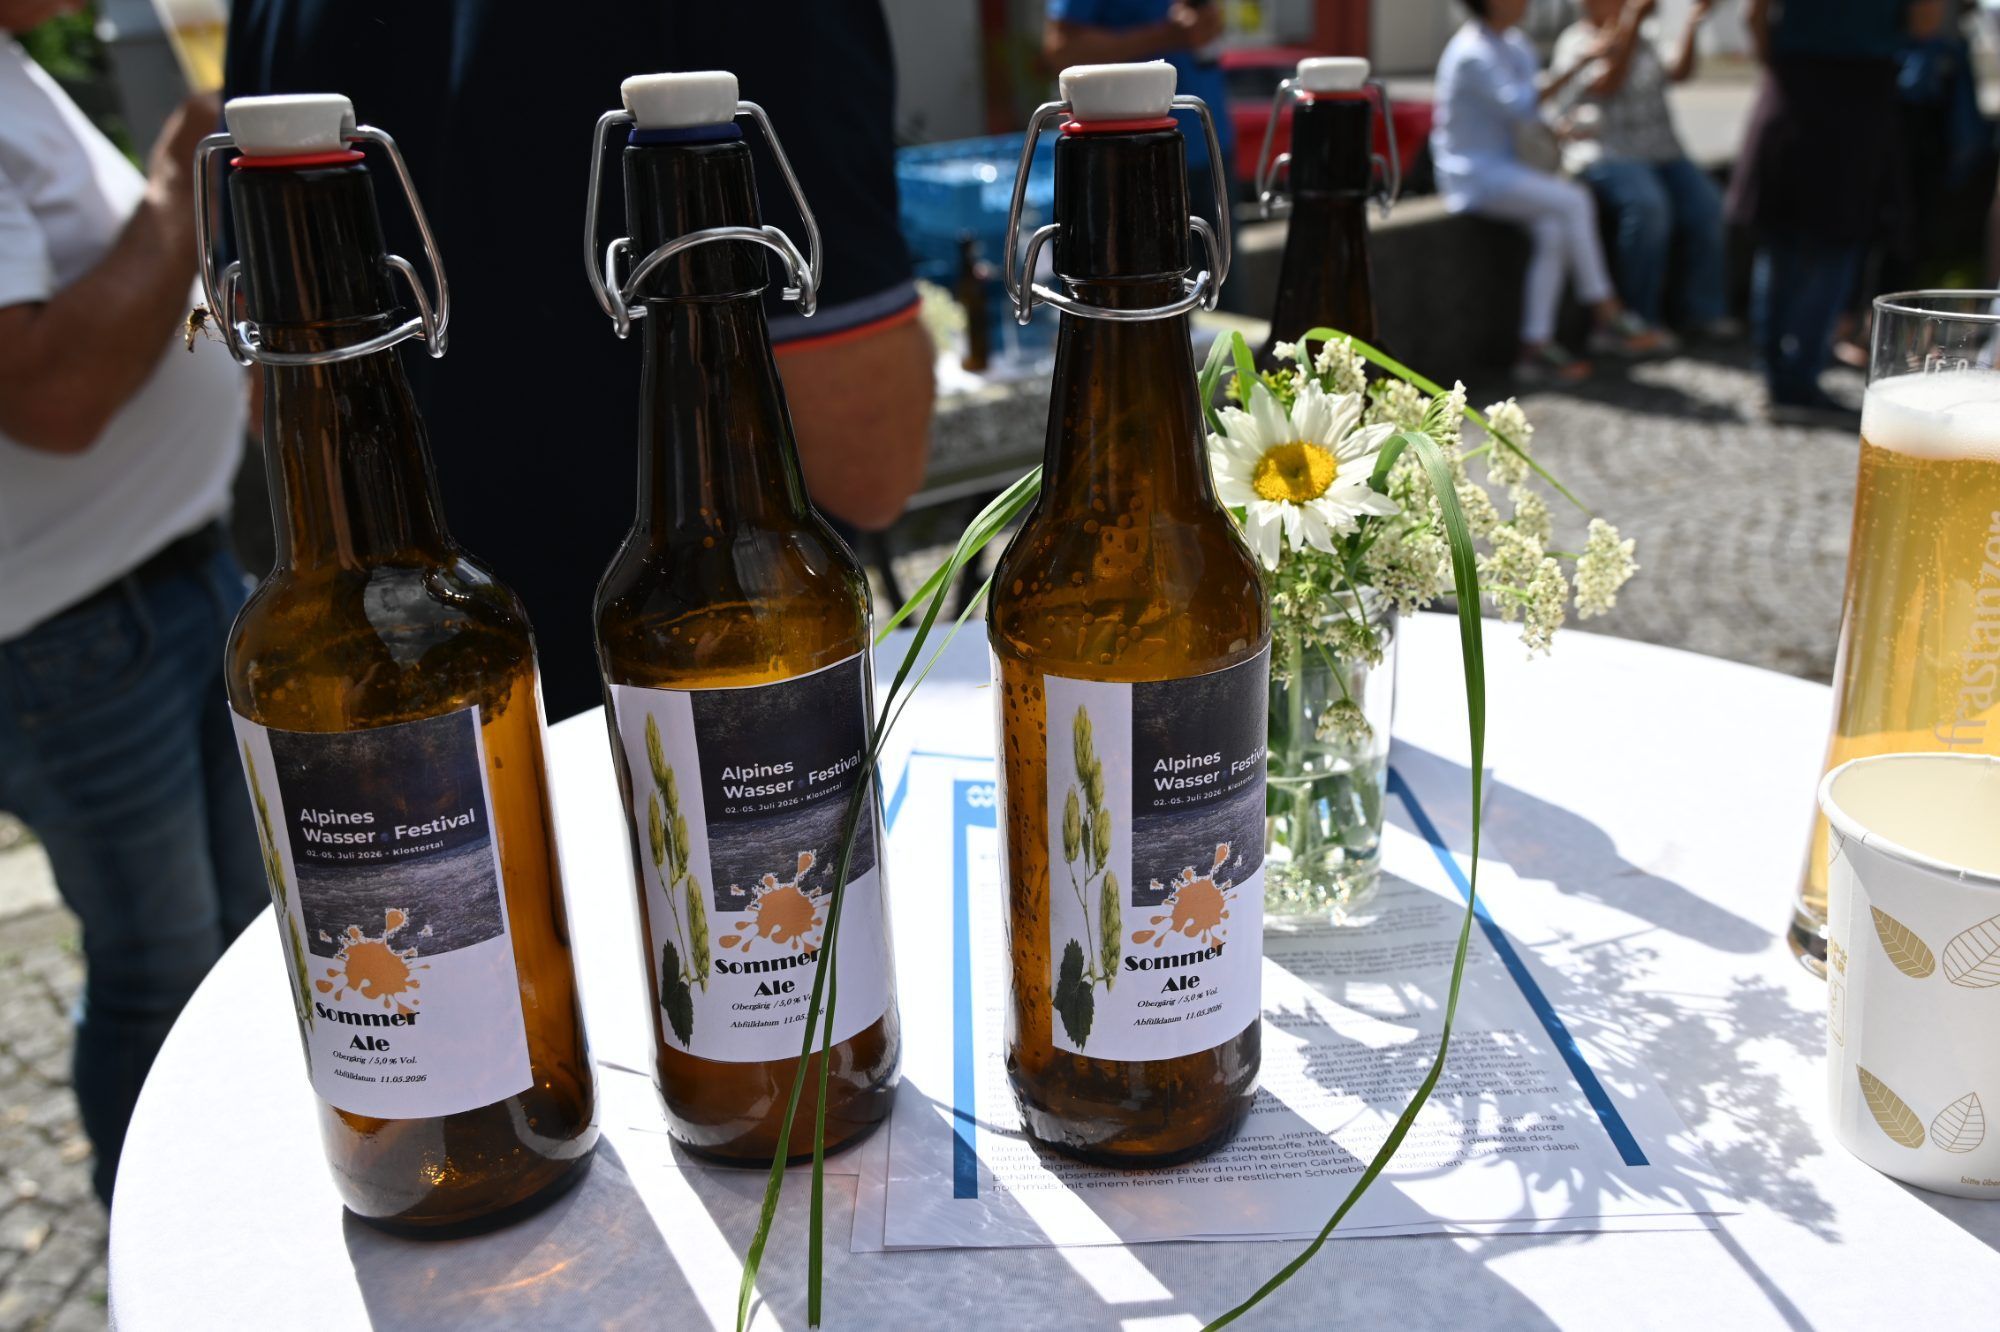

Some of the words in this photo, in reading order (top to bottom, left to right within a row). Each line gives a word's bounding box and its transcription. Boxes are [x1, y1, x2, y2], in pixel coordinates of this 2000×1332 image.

[722, 760, 793, 782] Alpines
[1153, 751, 1221, 774] Alpines
[1154, 769, 1220, 791] Wasser
[1231, 744, 1266, 776] Festiva
[723, 780, 793, 799] Wasser
[808, 749, 861, 785] Festival
[758, 802, 775, 811] Juli
[778, 797, 799, 808] 2026
[806, 781, 842, 801] Klostertal
[1186, 792, 1201, 802] Juli
[1203, 789, 1222, 799] 2026
[300, 808, 375, 827] Alpines
[303, 827, 376, 844] Wasser
[394, 808, 475, 840] Festival
[337, 851, 355, 860] Juli
[358, 851, 383, 860] 2026
[393, 840, 444, 857] Klostertal
[715, 948, 822, 975] Sommer
[1124, 942, 1226, 971] Sommer
[754, 979, 795, 997] Ale
[1161, 975, 1200, 994] Ale
[316, 1001, 420, 1027] Sommer
[732, 1003, 771, 1011] Obergärig
[1133, 1017, 1181, 1026] Abfülldatum
[1186, 1002, 1222, 1020] 11.05.2026
[1137, 999, 1176, 1008] Obergärig
[730, 1020, 780, 1028] Abfülldatum
[350, 1034, 391, 1052] Ale
[332, 1050, 367, 1065] Obergärig
[400, 1056, 418, 1065] Vol.
[333, 1068, 376, 1083] Abfülldatum
[380, 1074, 427, 1083] 11.05.2026
[1231, 1153, 1257, 1162] sich
[1260, 1152, 1281, 1161] ein
[1283, 1147, 1335, 1159] Großteil
[1493, 1134, 1527, 1144] Mitte
[1529, 1132, 1554, 1142] des
[1307, 1138, 1328, 1148] Mit
[1193, 1165, 1222, 1174] wird
[1225, 1164, 1252, 1172] nun
[1254, 1162, 1267, 1171] in
[1270, 1160, 1308, 1170] einen
[1494, 1143, 1541, 1154] besten
[1542, 1142, 1580, 1152] dabei
[1086, 1178, 1129, 1189] einem
[1132, 1177, 1174, 1187] feinen
[1177, 1175, 1210, 1185] Filter
[1213, 1174, 1234, 1183] die
[1237, 1170, 1303, 1182] restlichen
[1304, 1164, 1368, 1178] Schwebst
